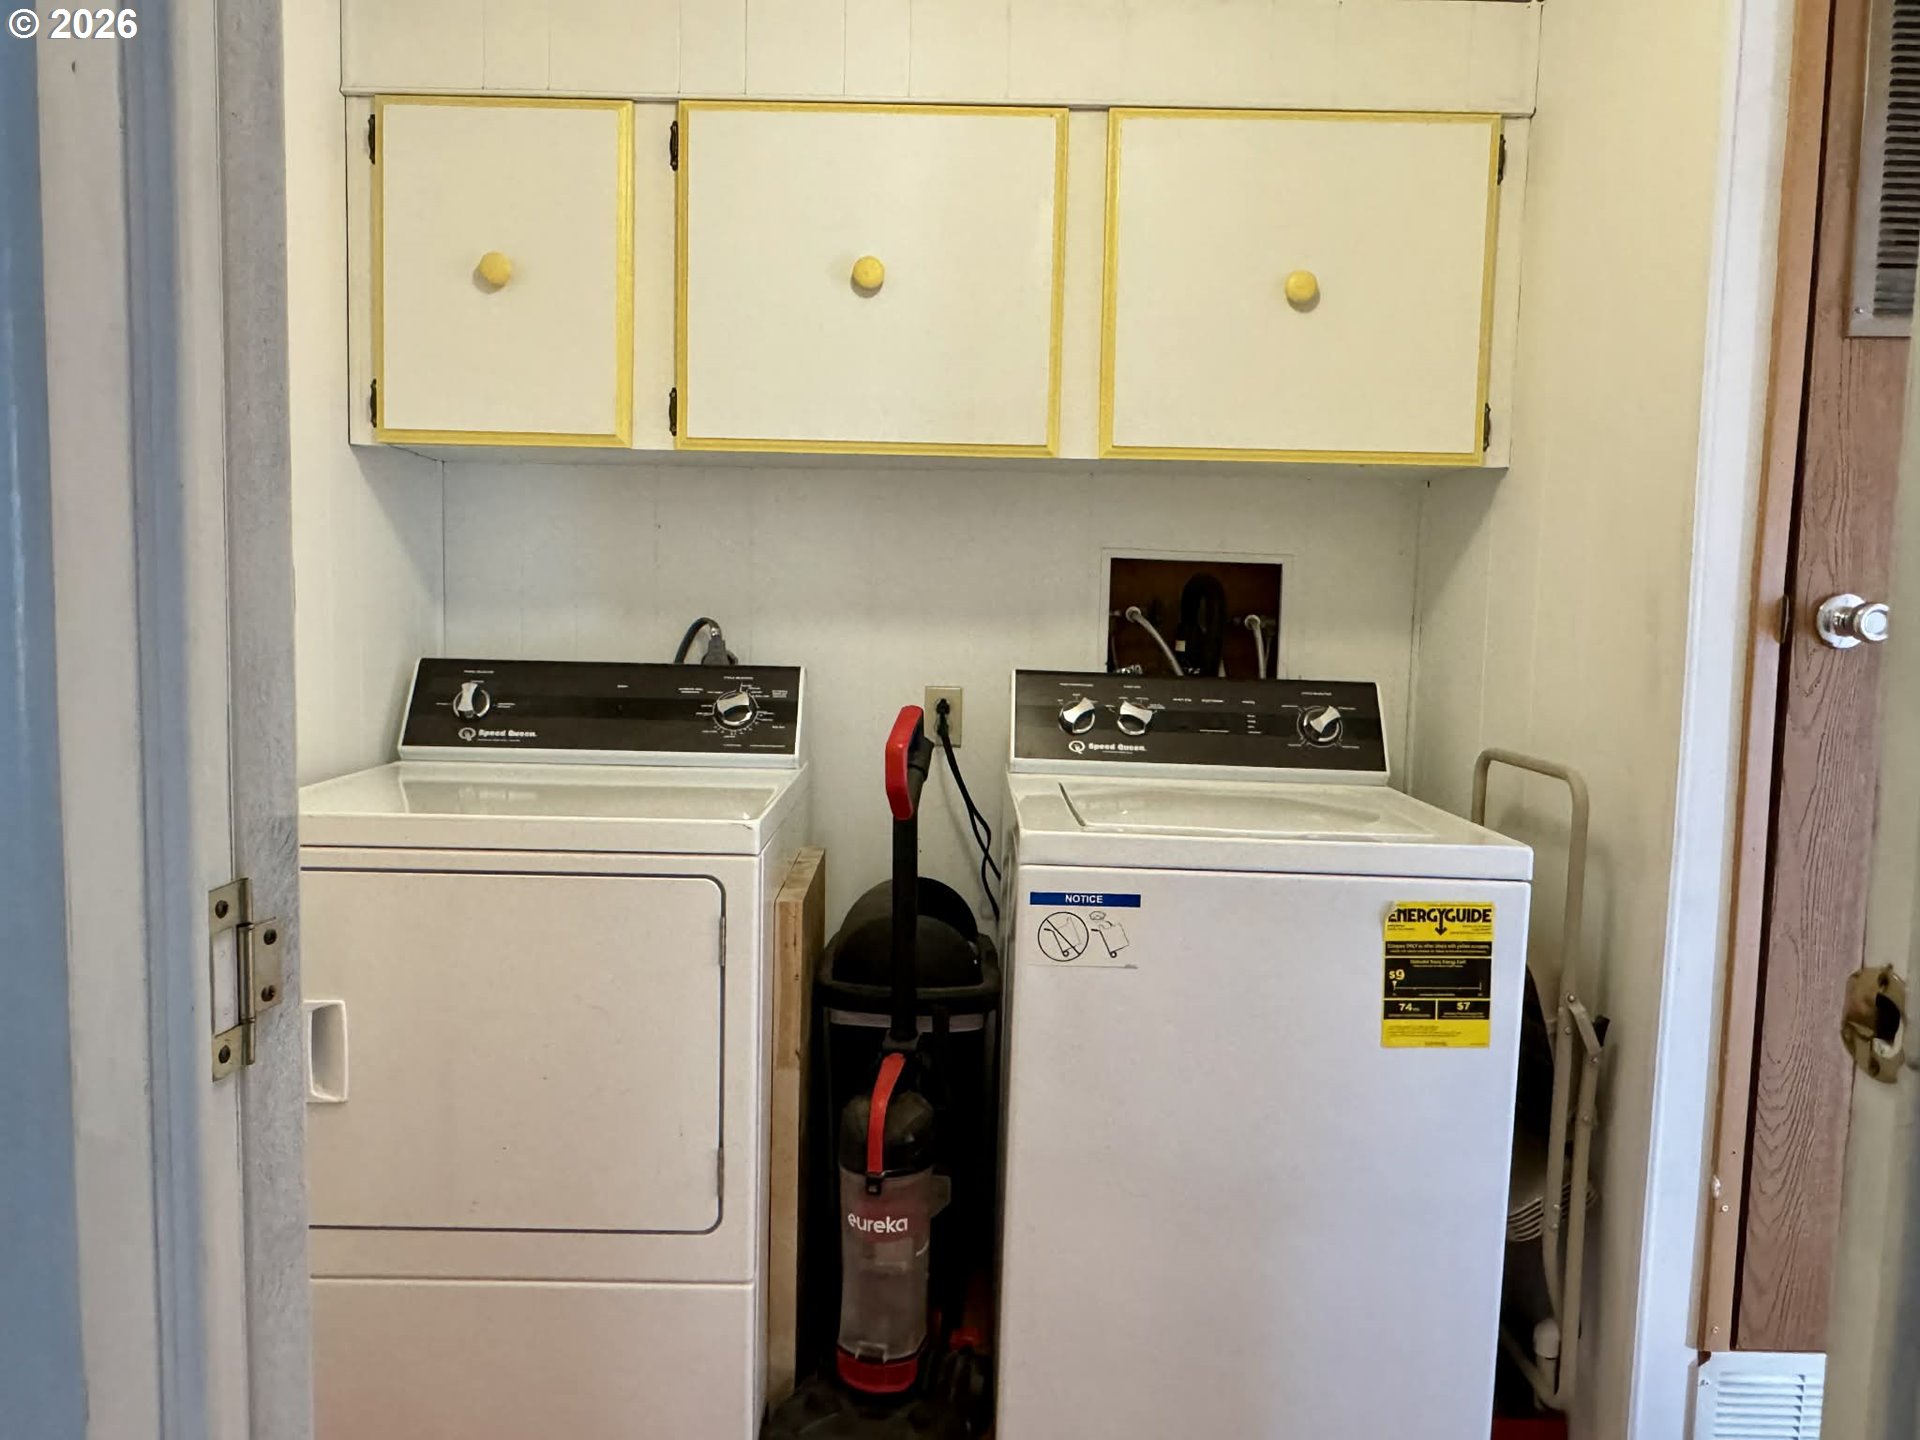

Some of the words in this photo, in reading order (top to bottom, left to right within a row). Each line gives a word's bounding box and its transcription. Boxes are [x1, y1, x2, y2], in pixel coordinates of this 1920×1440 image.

[478, 729, 507, 738] Speed
[1088, 742, 1116, 751] Speed
[1065, 894, 1104, 904] NOTICE
[1389, 969, 1405, 980] $9
[1398, 1002, 1413, 1011] 74
[847, 1213, 909, 1234] eureka
